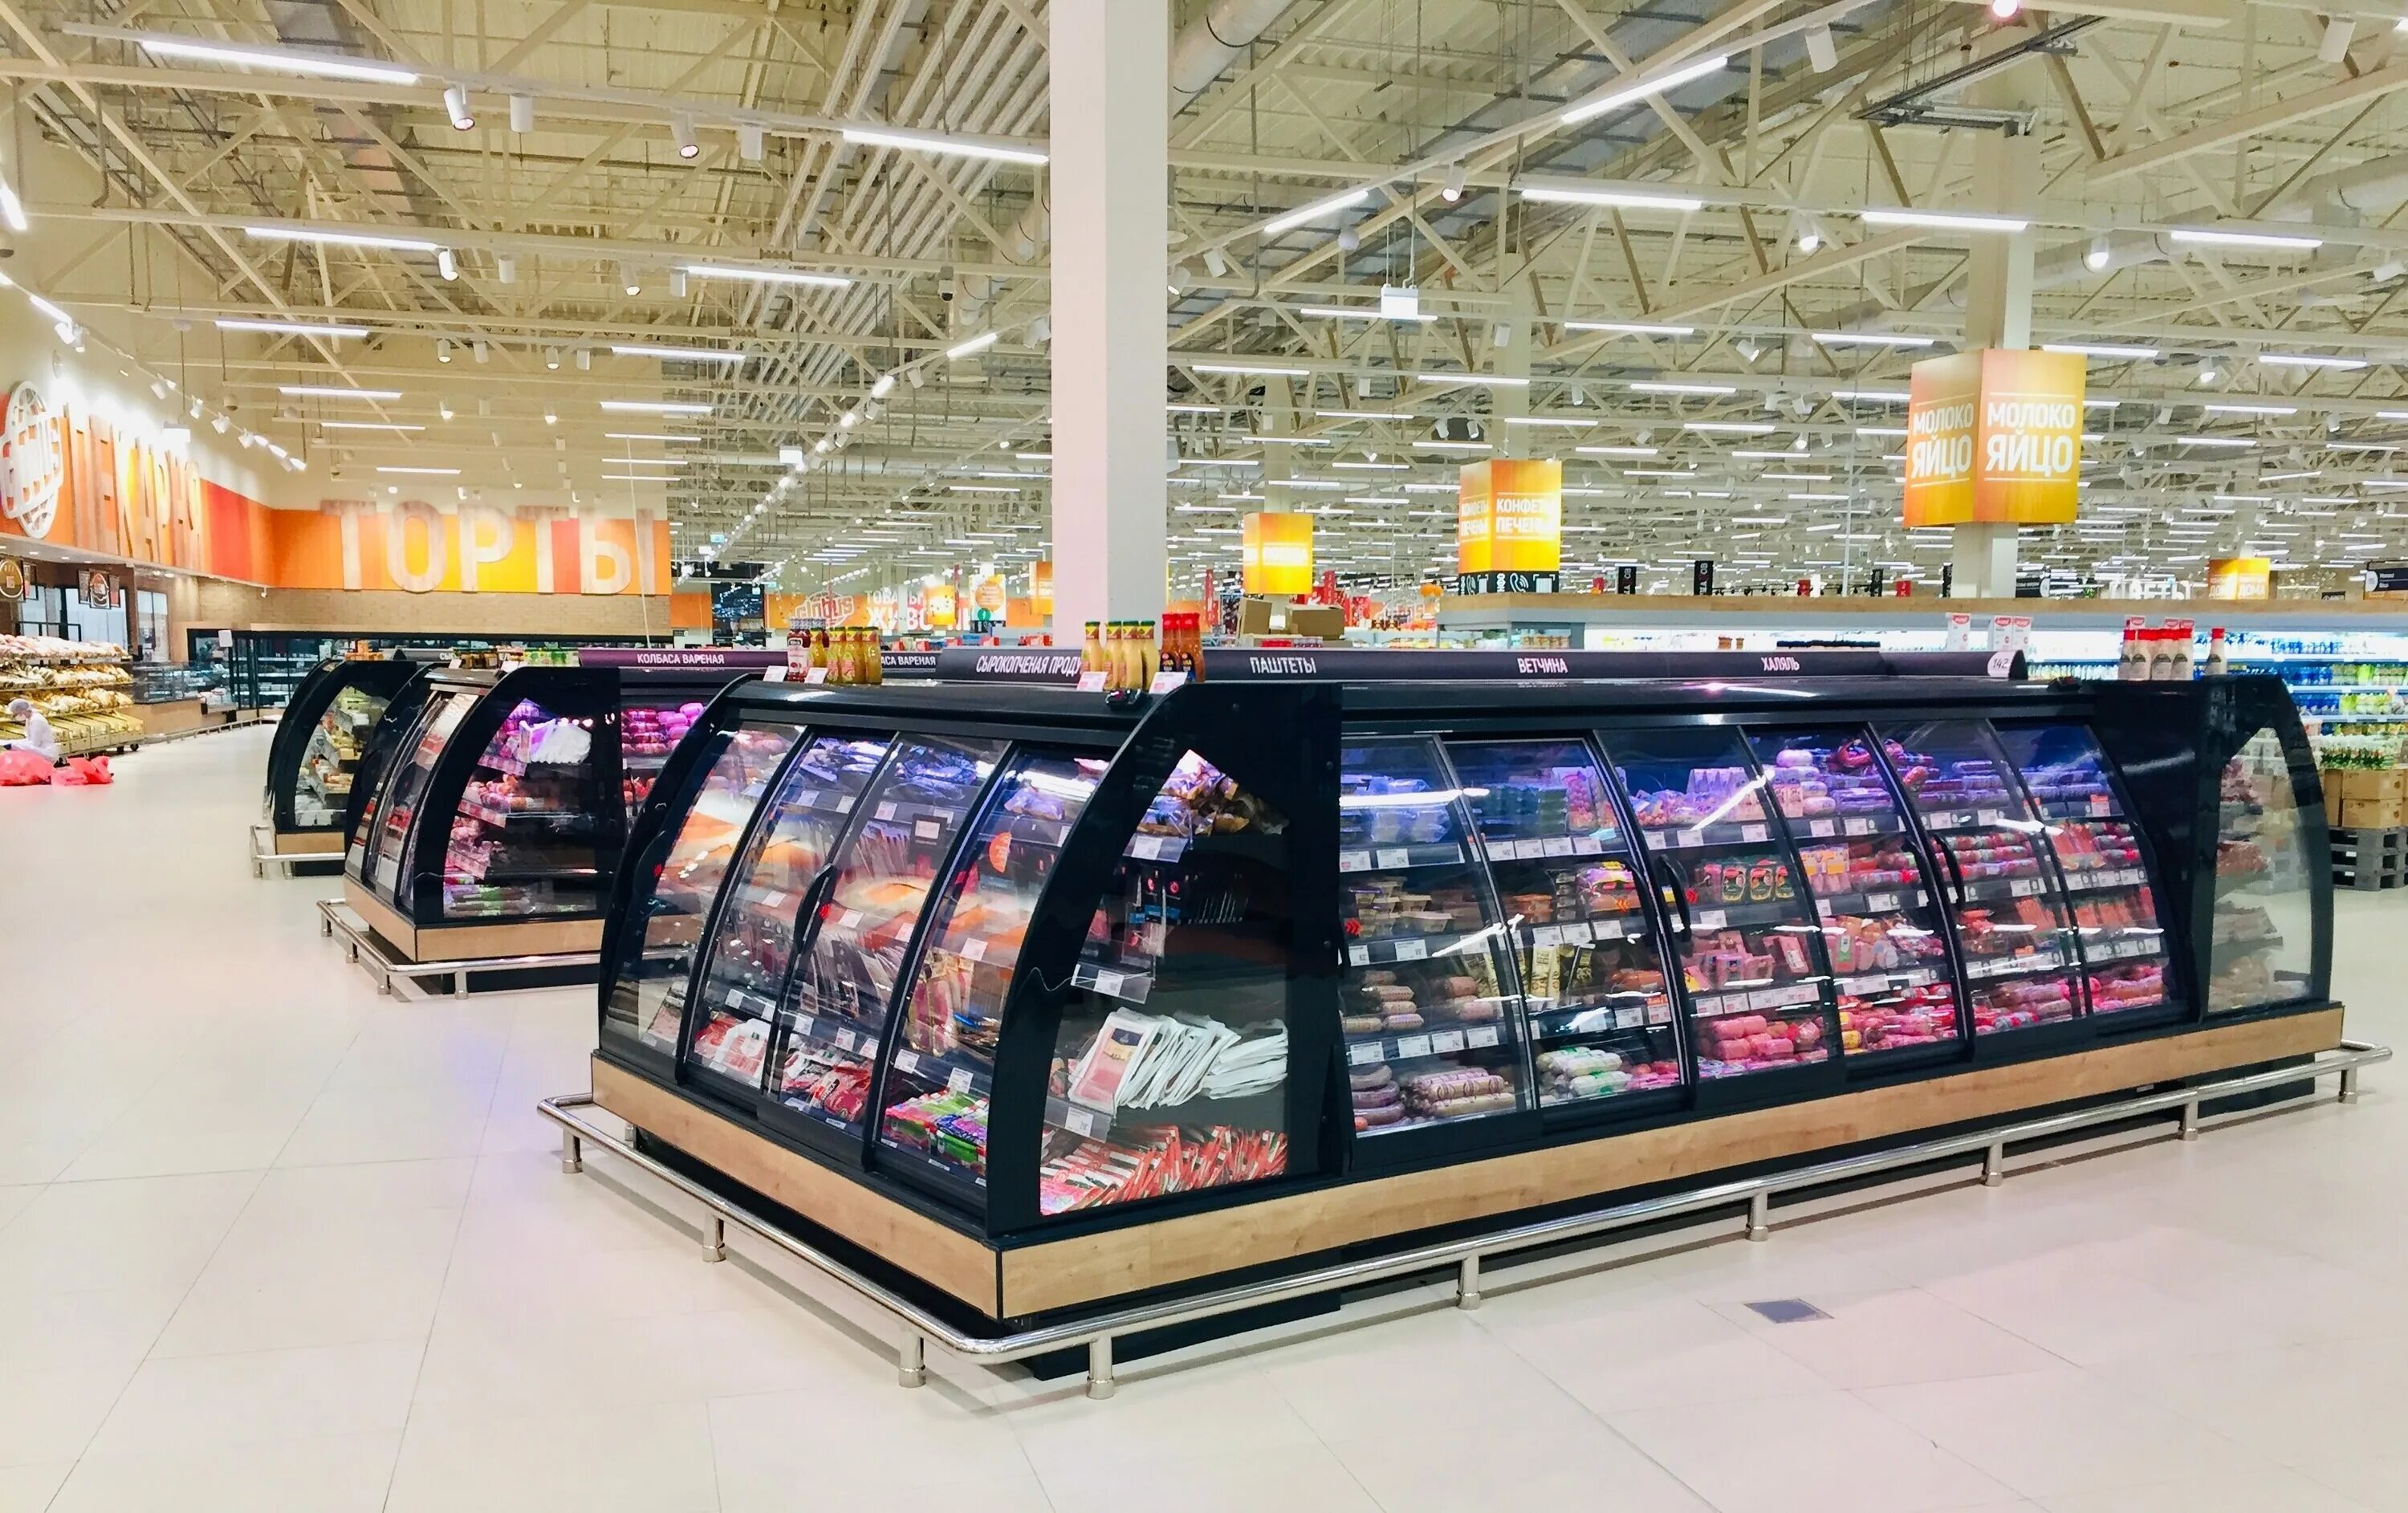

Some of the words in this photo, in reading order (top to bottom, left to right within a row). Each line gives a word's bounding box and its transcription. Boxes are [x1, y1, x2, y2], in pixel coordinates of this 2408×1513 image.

[1913, 403, 1975, 436] МОЛОКО
[1987, 402, 2076, 429] МОЛОКО
[1911, 433, 1972, 478] ЯЙЦО
[1985, 429, 2073, 477] ЯЙЦО
[322, 500, 655, 596] ТОРТЫ
[637, 653, 681, 664] КОЛБАСА
[682, 654, 725, 664] ВАРЕНАЯ
[898, 656, 936, 665] ВАРЕНАЯ
[976, 655, 1050, 673] СЫРОКОПЧЕНАЯ
[1048, 656, 1082, 677] ПРОДУ
[1250, 657, 1317, 674] ПАШТЕТЫ
[1517, 658, 1568, 673] ВЕТЧИНА
[1761, 657, 1800, 671] ХАЛЯЛЬ
[1993, 658, 2009, 669] 142
